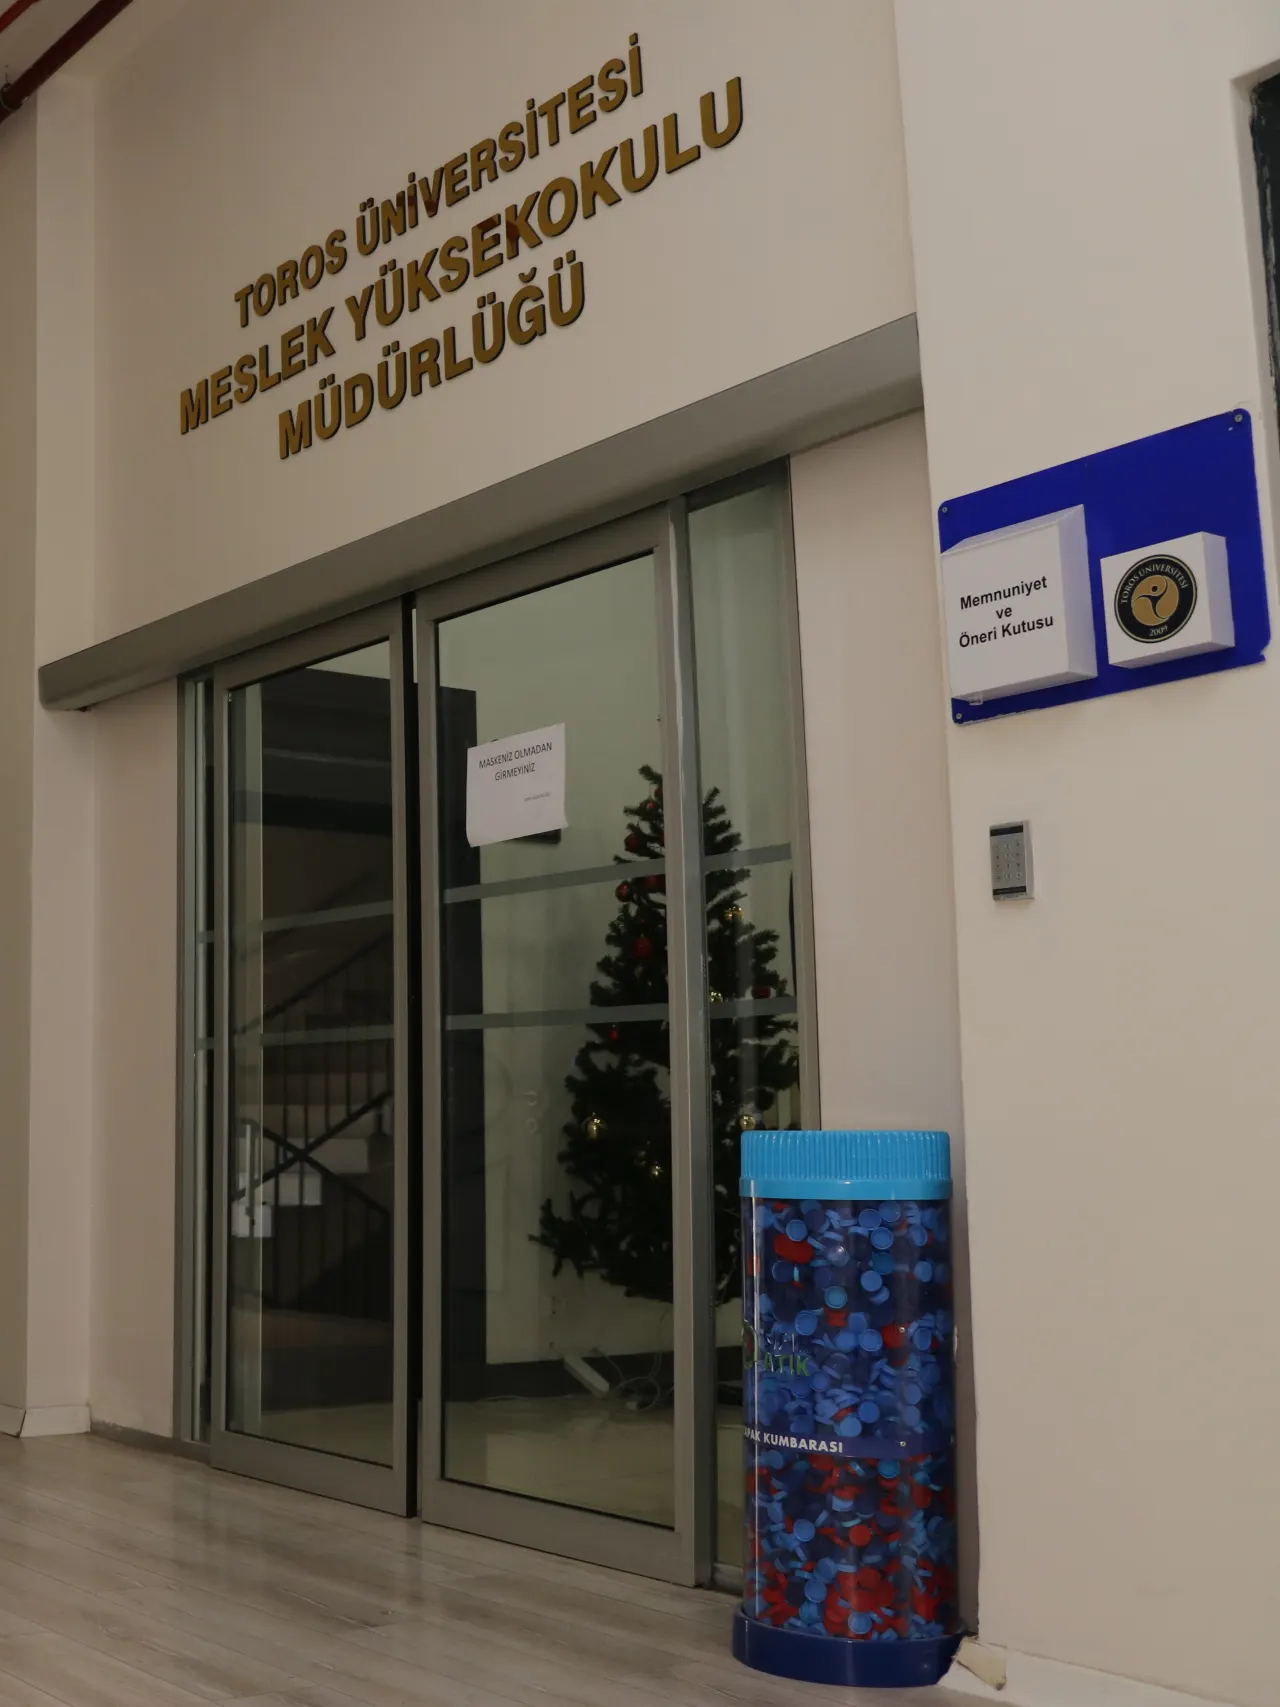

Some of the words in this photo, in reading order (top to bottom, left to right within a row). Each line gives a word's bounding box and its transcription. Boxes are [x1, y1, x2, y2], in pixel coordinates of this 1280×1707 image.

[234, 229, 348, 328] TOROS
[355, 32, 644, 256] ÜNİVERSİTESİ
[180, 306, 337, 435] MESLEK
[344, 76, 743, 341] YÜKSEKOKULU
[278, 249, 586, 460] MÜDÜRLÜĞÜ
[960, 576, 1048, 610] Memnuniyet
[1121, 575, 1139, 604] TOROS
[996, 607, 1013, 620] ve
[959, 626, 997, 648] Öneri
[1001, 616, 1054, 638] Kutusu
[1149, 625, 1168, 637] 2009
[514, 741, 553, 760] OLMADAN
[764, 1351, 811, 1376] ATIK
[763, 1432, 843, 1453] KUMBARASI
